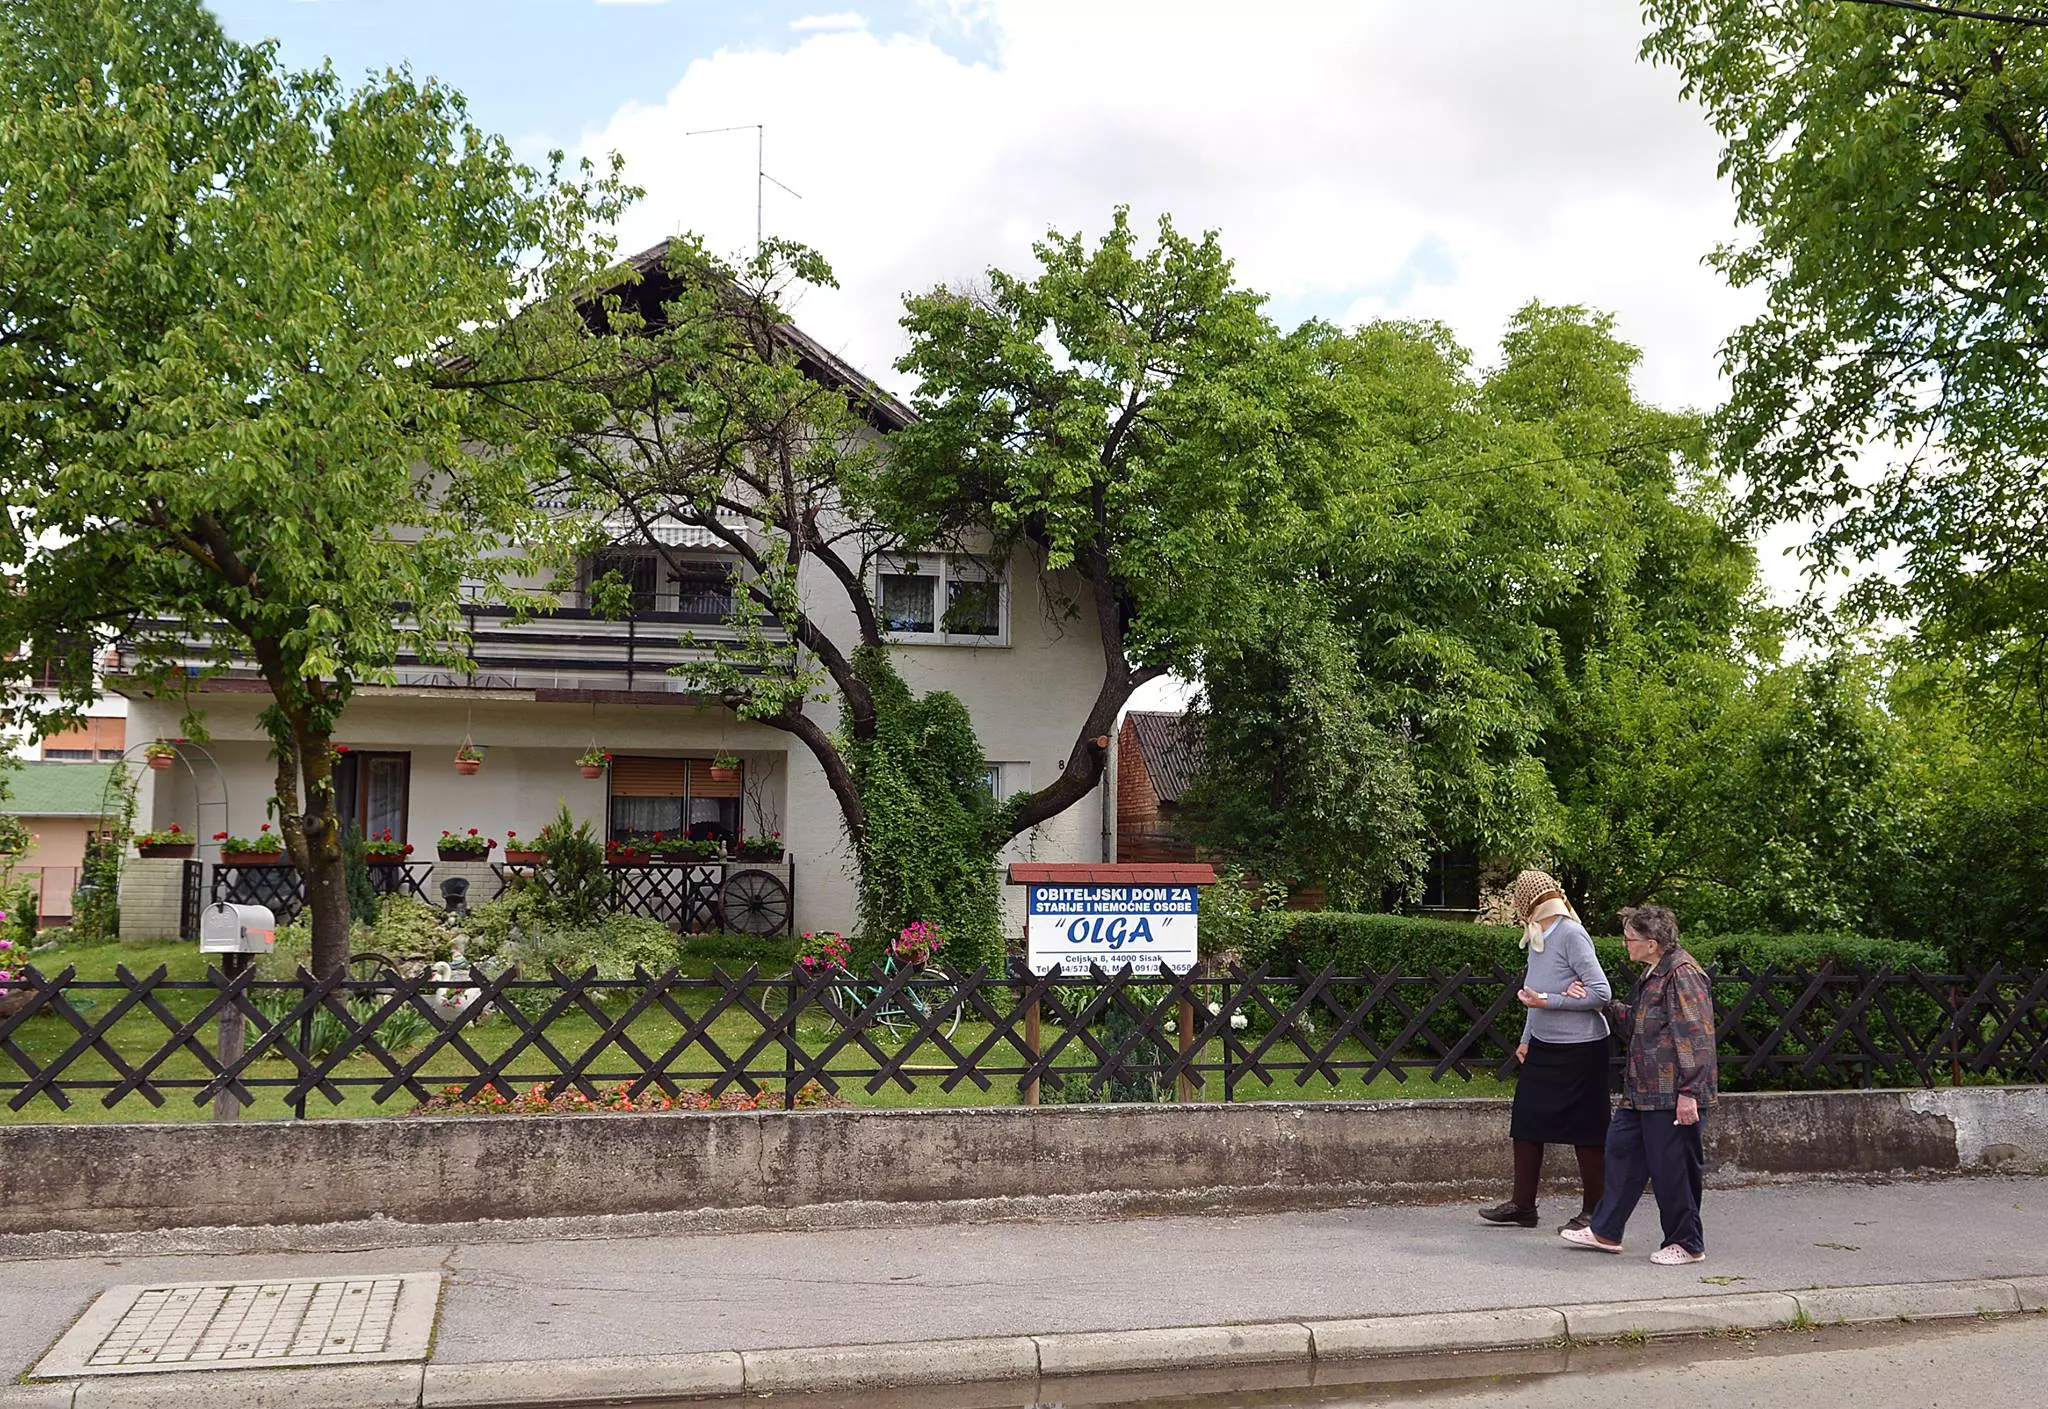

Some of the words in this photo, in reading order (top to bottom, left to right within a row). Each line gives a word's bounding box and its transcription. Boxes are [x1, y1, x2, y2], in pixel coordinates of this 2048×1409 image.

[1059, 760, 1064, 770] 8
[1036, 888, 1127, 901] OBITELJSKI
[1131, 888, 1167, 901] DOM
[1171, 888, 1192, 901] ZA
[1036, 902, 1084, 912] STARIJE
[1087, 902, 1090, 912] I
[1094, 899, 1150, 912] NEMOĆNE
[1153, 902, 1192, 912] OSOBE
[1065, 955, 1098, 964] Celjska
[1100, 955, 1109, 963] 8,
[1139, 954, 1162, 962] Sisak
